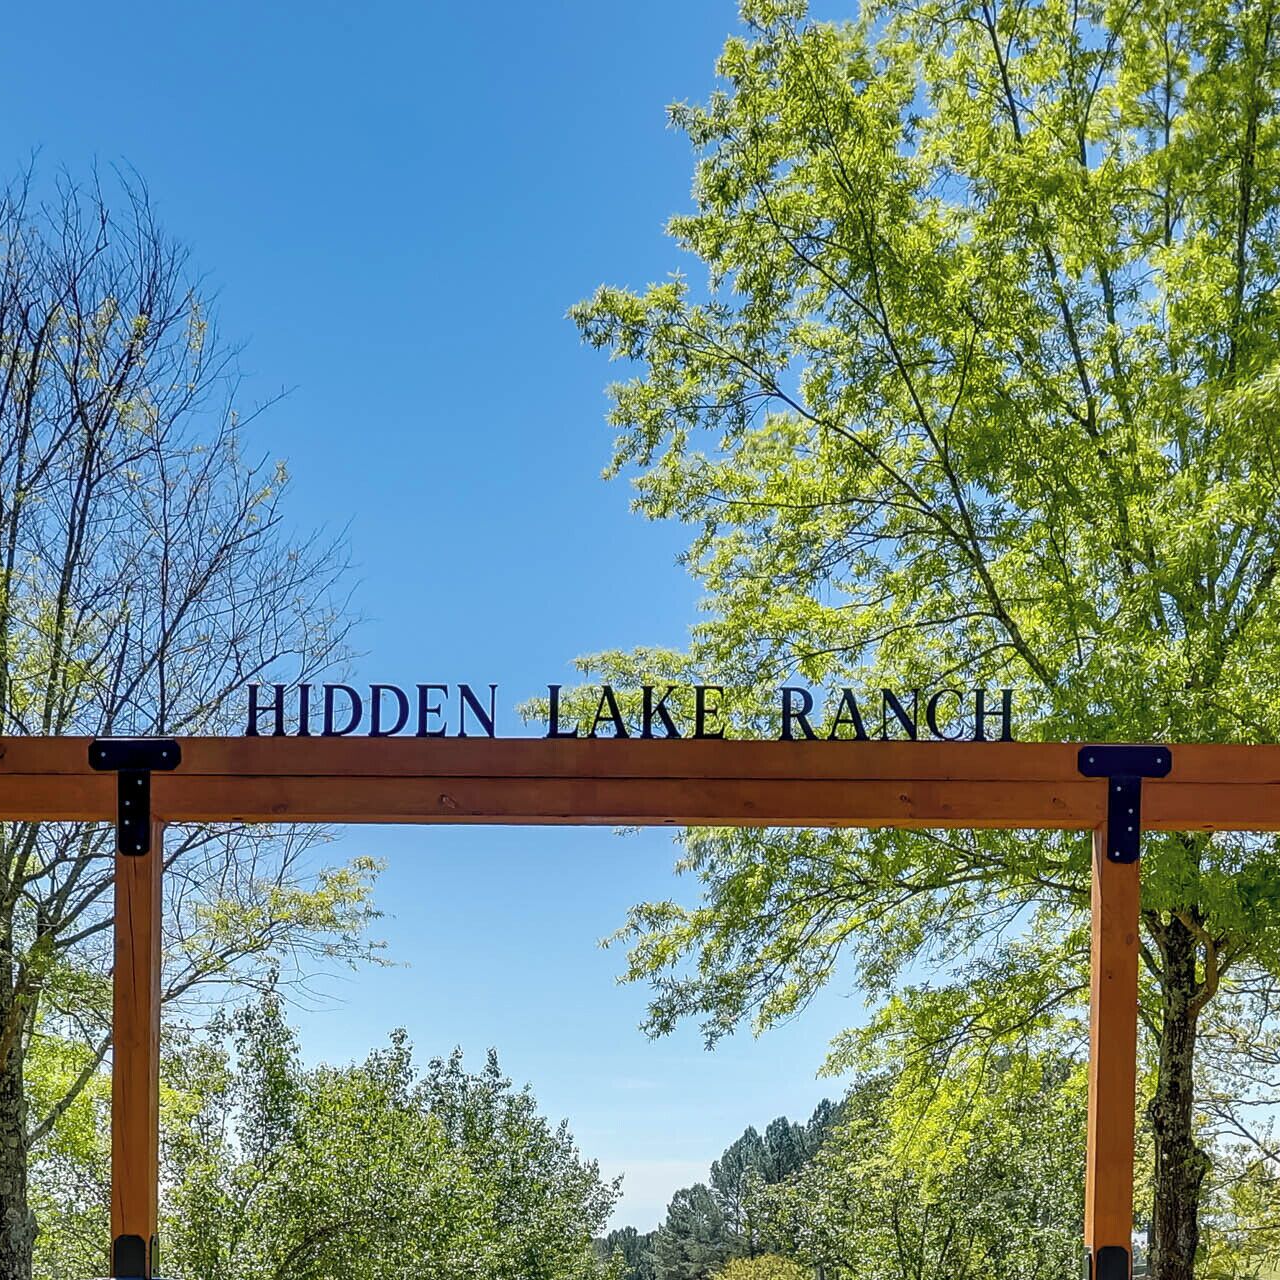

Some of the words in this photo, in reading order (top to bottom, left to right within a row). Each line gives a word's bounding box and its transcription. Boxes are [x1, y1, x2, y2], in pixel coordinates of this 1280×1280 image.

[244, 683, 499, 738] HIDDEN
[544, 684, 725, 739] LAKE
[778, 687, 1015, 741] RANCH
